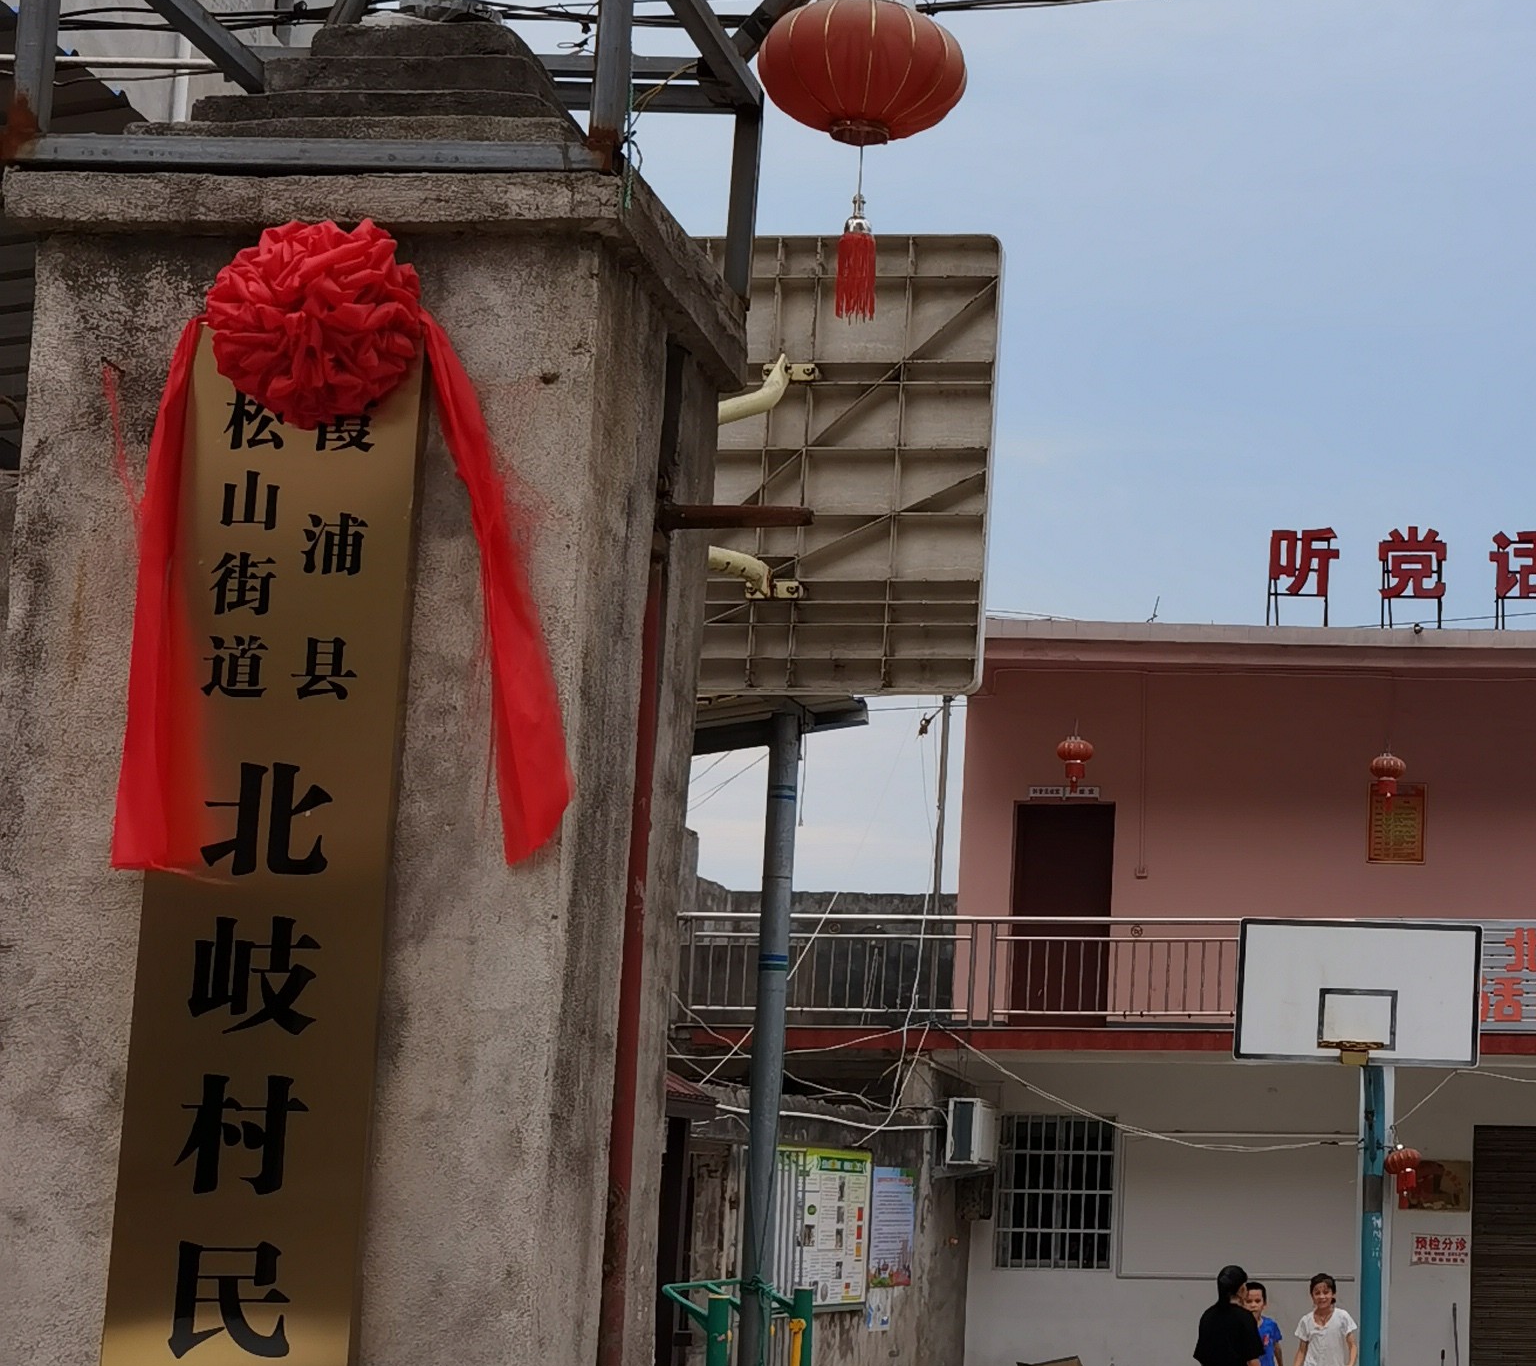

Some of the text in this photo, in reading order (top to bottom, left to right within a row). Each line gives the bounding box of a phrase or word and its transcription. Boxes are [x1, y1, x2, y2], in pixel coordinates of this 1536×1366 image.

[200, 390, 285, 701] 松山街道
[290, 399, 376, 701] 霞浦县
[1415, 1236, 1468, 1251] 预检分诊
